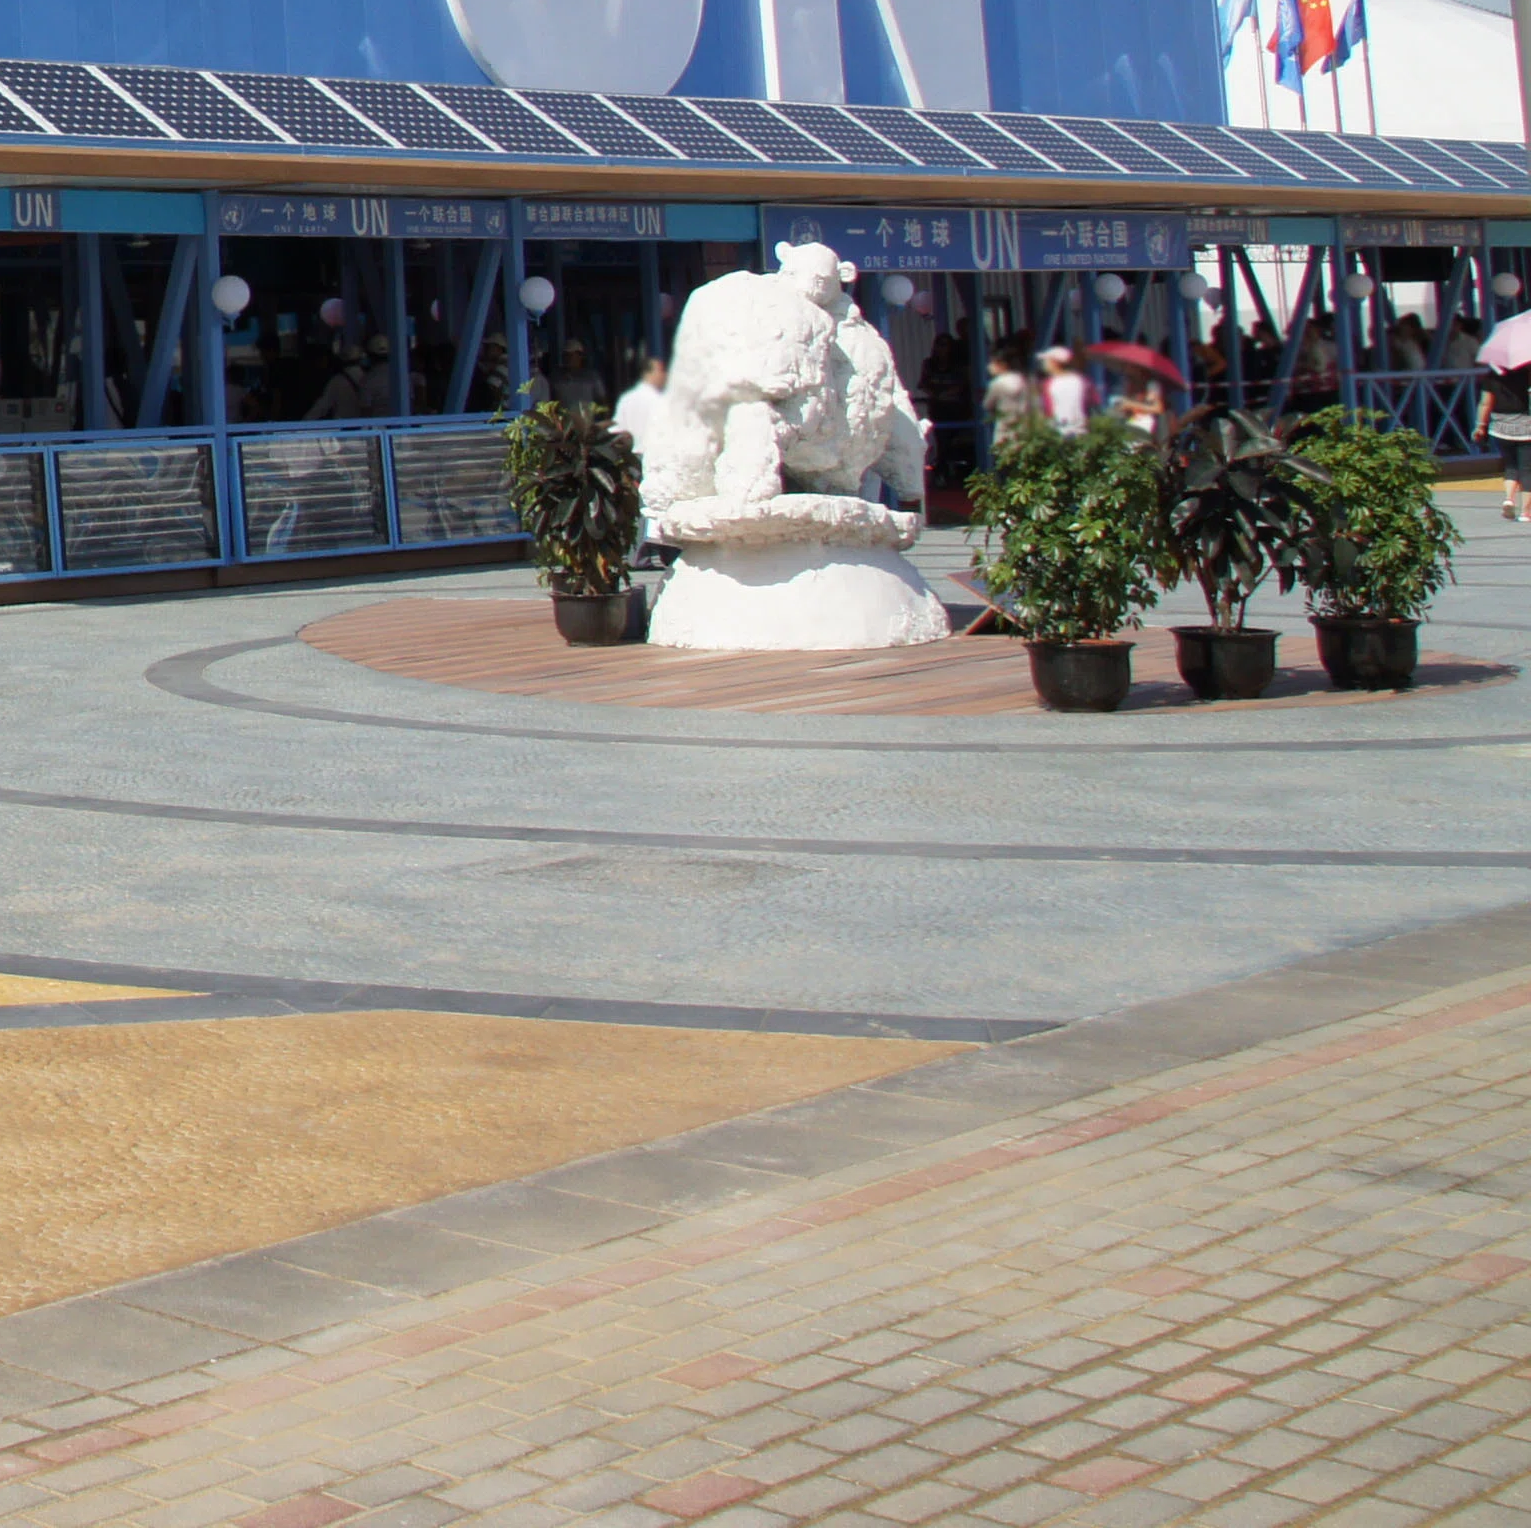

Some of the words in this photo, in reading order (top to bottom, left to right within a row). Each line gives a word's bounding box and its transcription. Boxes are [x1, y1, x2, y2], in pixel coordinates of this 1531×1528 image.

[15, 192, 53, 227] UN
[350, 198, 389, 236] UN
[634, 207, 660, 235] UN
[846, 218, 950, 248] 一个地球
[969, 210, 1020, 270] UN
[1041, 220, 1128, 249] 一个联合国
[864, 256, 888, 268] ONE
[899, 256, 937, 268] EARTH
